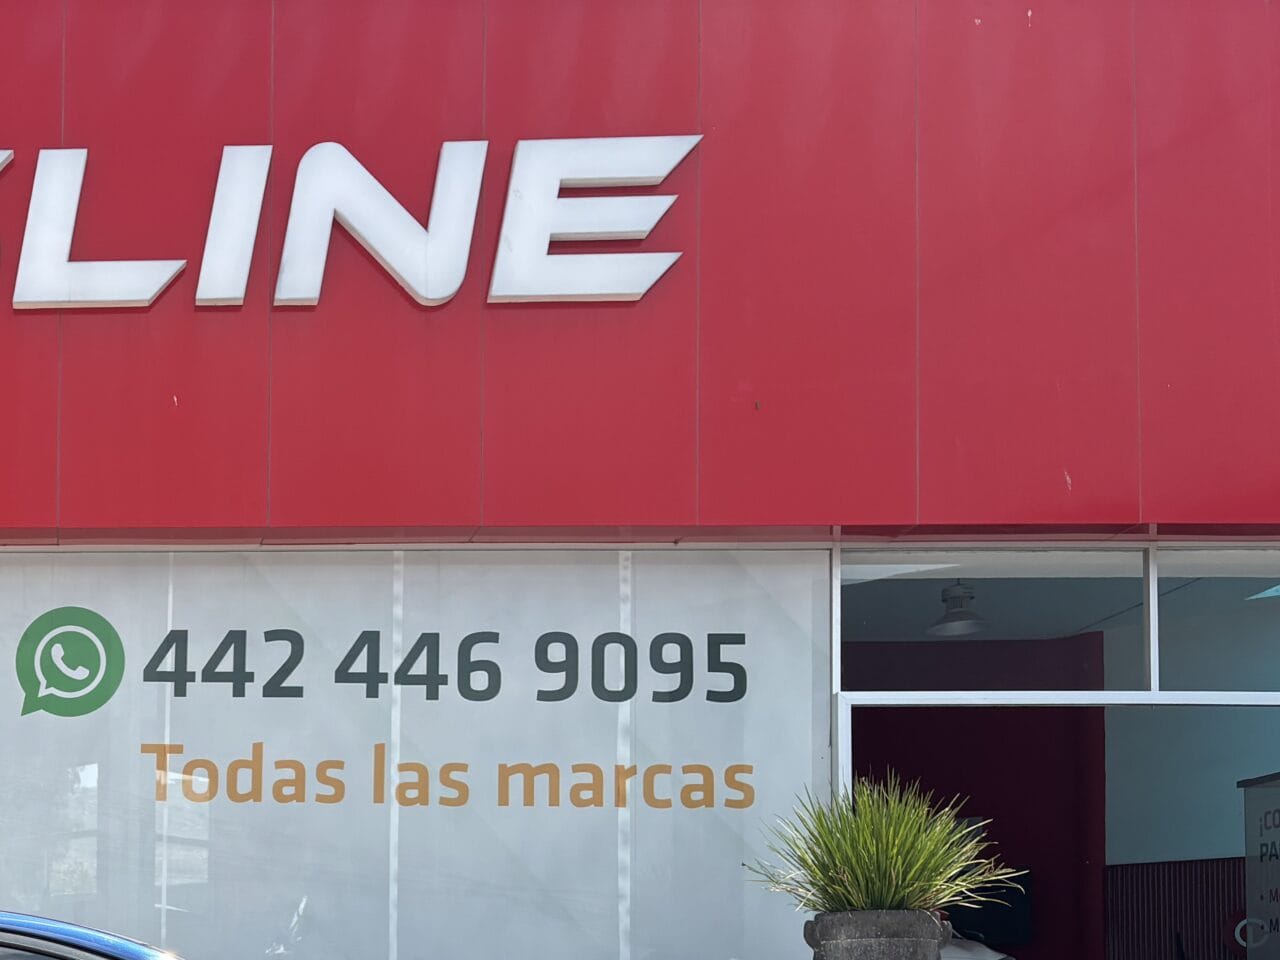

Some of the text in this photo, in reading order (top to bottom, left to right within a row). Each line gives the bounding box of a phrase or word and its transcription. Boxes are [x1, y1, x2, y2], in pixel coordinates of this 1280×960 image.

[142, 627, 749, 704] 442 446 9095
[140, 740, 757, 810] Todas las marcas
